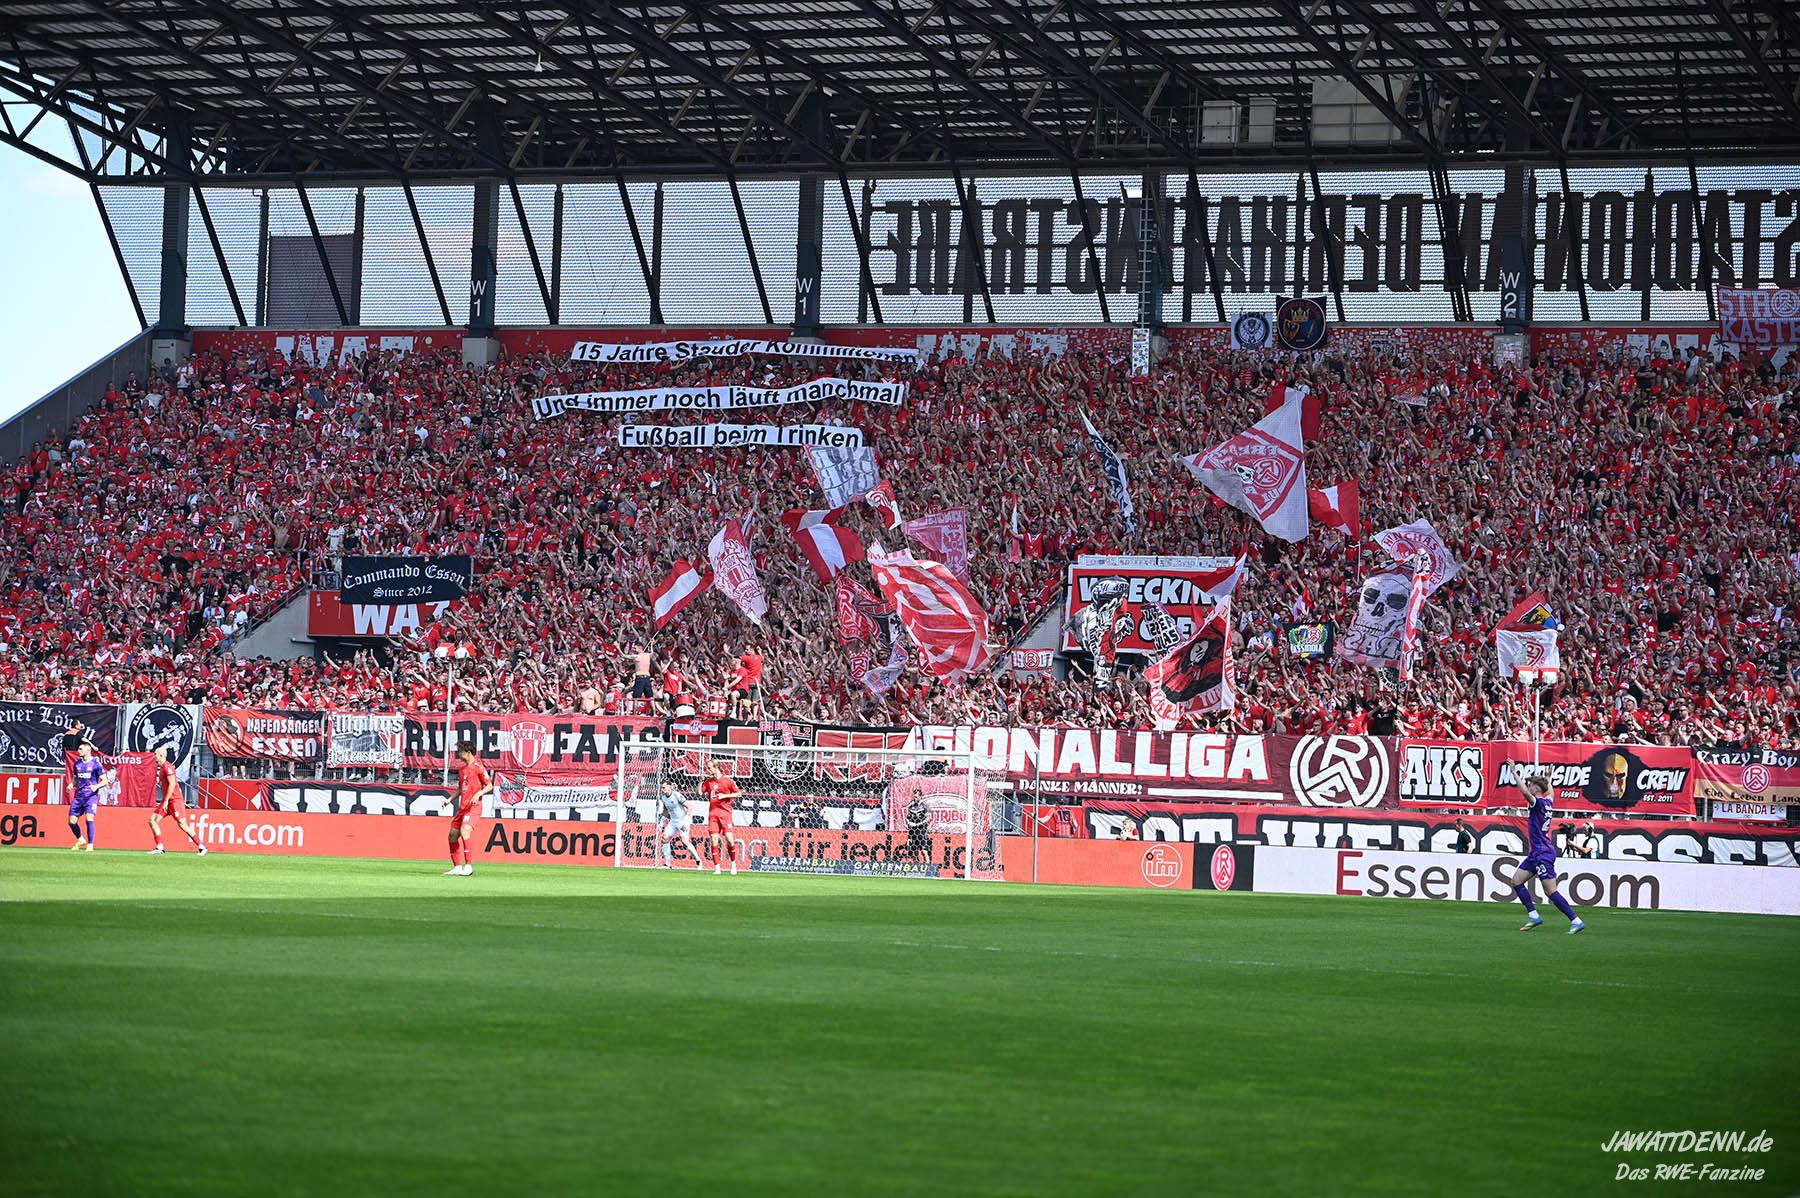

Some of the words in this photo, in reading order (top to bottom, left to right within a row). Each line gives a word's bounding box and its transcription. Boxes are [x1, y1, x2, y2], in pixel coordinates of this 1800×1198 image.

[471, 280, 487, 296] W
[797, 278, 813, 293] W
[1502, 271, 1520, 289] W
[474, 299, 482, 317] 1
[800, 297, 807, 315] 1
[1504, 292, 1517, 312] 2
[577, 343, 603, 360] 15
[606, 344, 668, 362] Jahre
[537, 395, 579, 417] Und
[586, 394, 657, 411] immer
[664, 389, 721, 410] noch
[729, 387, 780, 409] läuft
[786, 383, 900, 404] manchmal
[622, 426, 705, 446] Fußball
[714, 426, 768, 445] beim
[775, 427, 859, 448] Trinken
[343, 564, 420, 589] Commando
[373, 586, 404, 598] Since
[407, 585, 433, 598] 2012
[1079, 577, 1213, 605] WECKIN
[403, 719, 500, 759] RUDE
[550, 723, 661, 763] FANS
[11, 745, 48, 763] 1980
[1401, 746, 1481, 802] AKS
[1636, 769, 1686, 791] CREW
[524, 788, 608, 803] Kommilitonen
[1019, 779, 1070, 794] DANKE
[1076, 779, 1143, 796] MÄNNER!
[188, 813, 305, 847] ifm.com
[485, 822, 768, 862] Automatiserung
[761, 856, 837, 868] GARTENBAU
[854, 861, 929, 873] GARTENBAU
